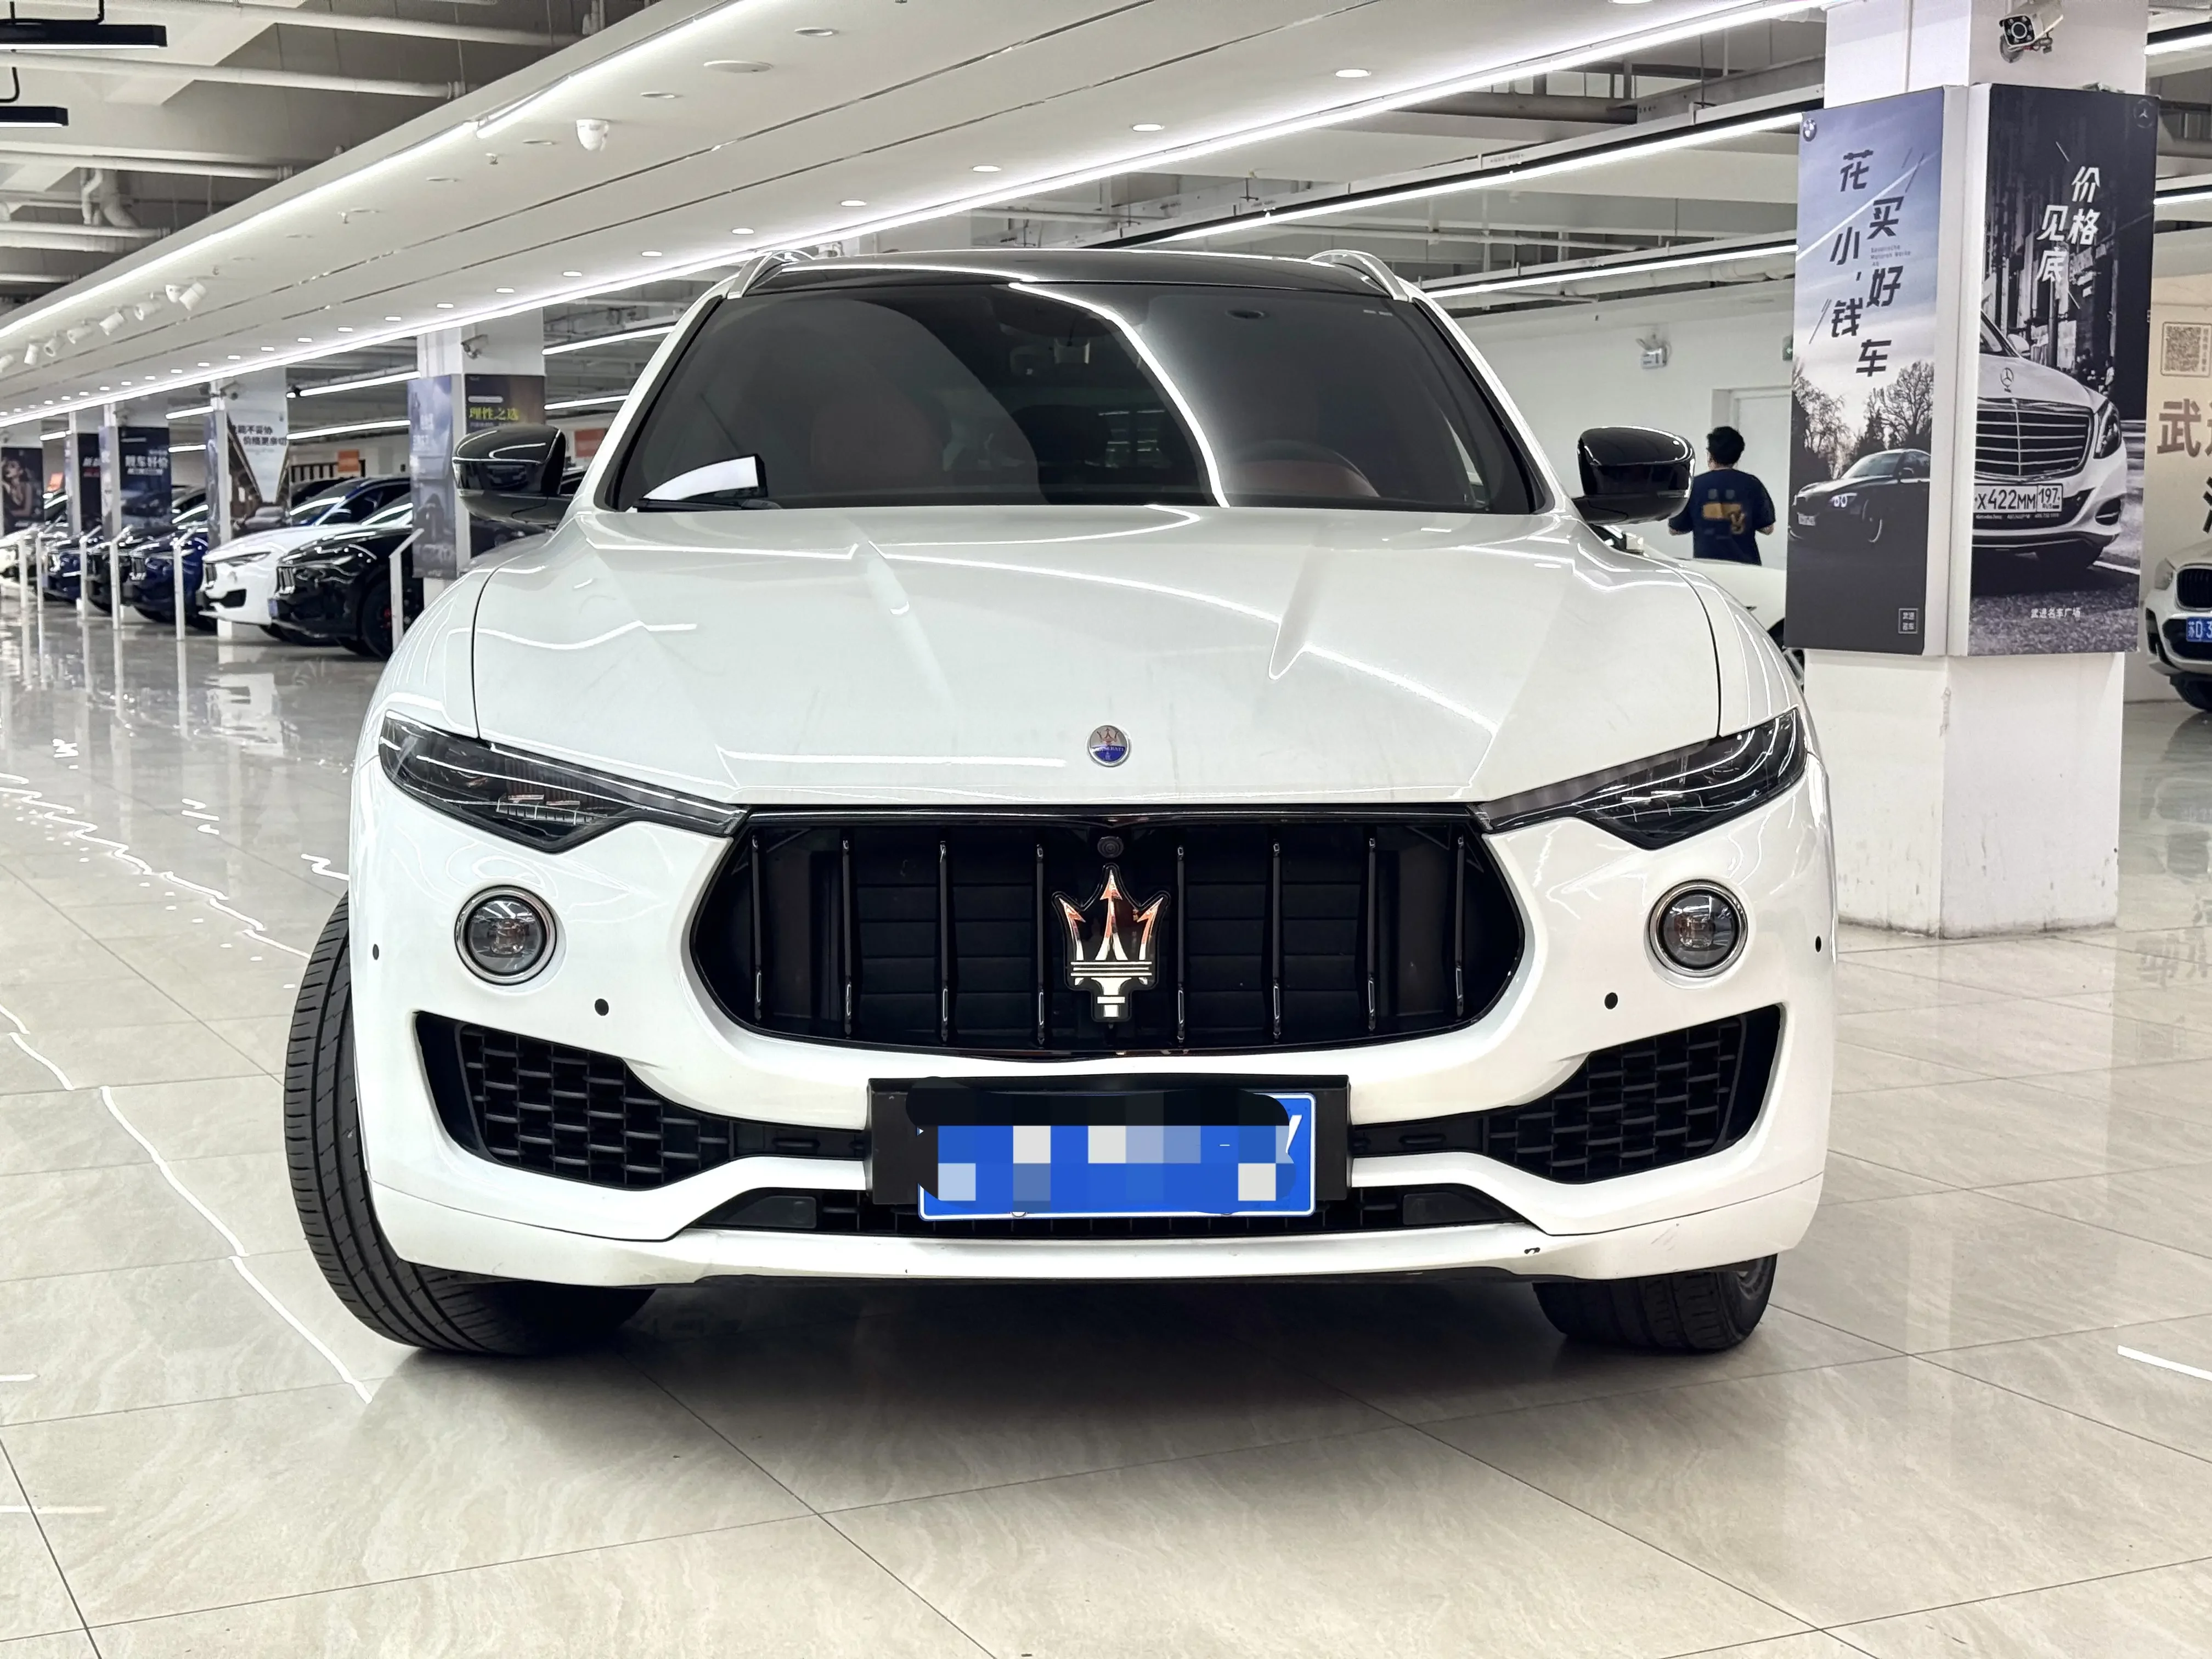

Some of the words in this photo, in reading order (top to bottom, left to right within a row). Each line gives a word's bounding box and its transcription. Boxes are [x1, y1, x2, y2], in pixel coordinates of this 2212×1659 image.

[2036, 205, 2070, 283] 见底
[2067, 166, 2101, 246] 价格
[1855, 196, 1904, 377] 买好车
[2157, 399, 2212, 458] 武
[2039, 488, 2058, 503] 197
